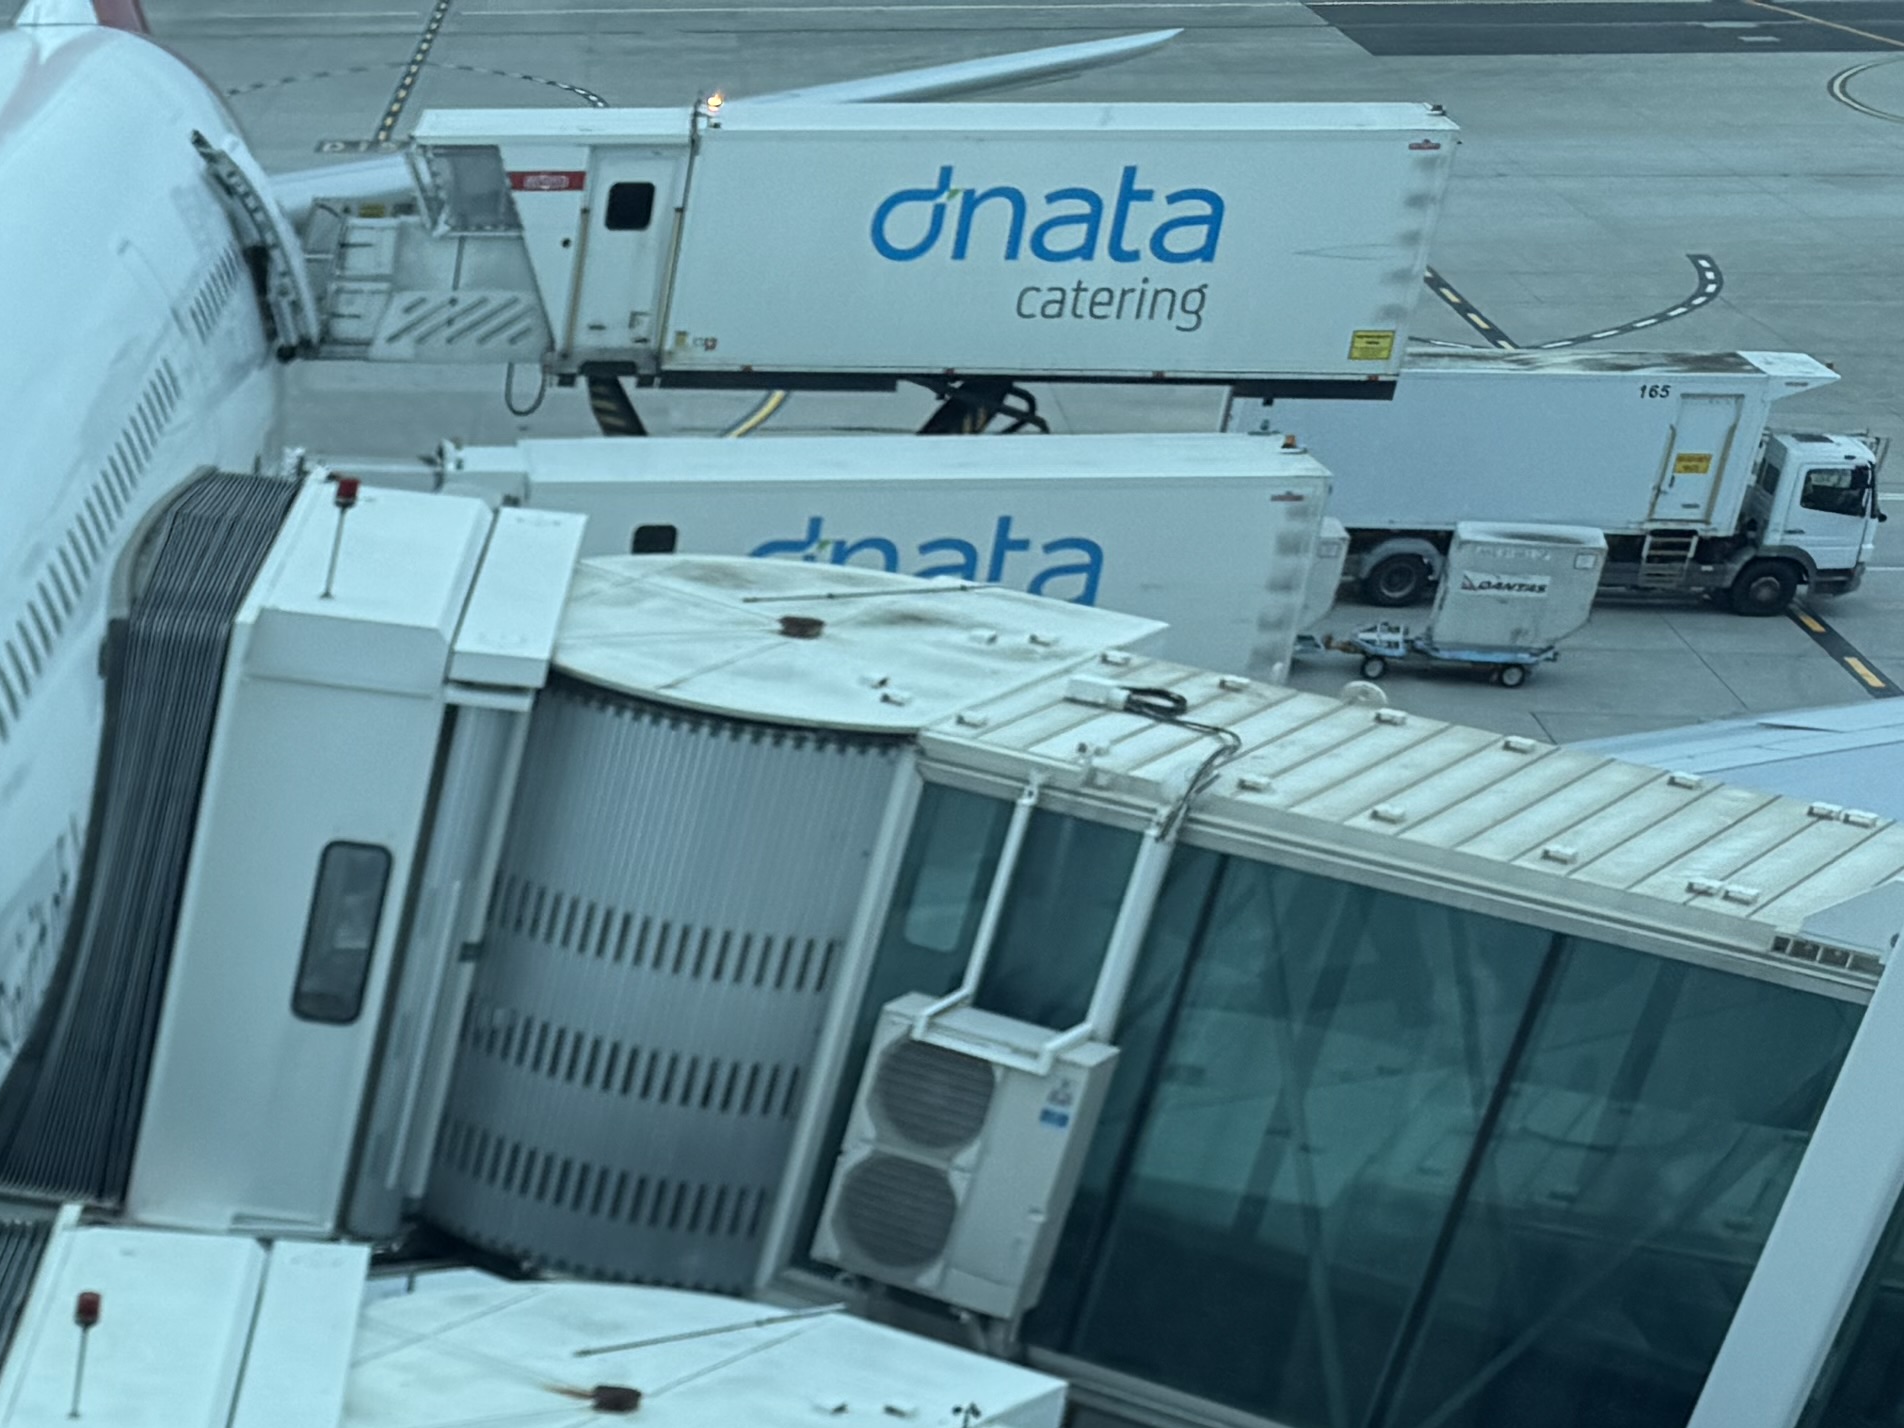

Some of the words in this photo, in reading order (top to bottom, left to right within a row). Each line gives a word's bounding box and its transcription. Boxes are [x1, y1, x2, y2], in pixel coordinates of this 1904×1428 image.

[869, 165, 1226, 265] dnata
[1015, 277, 1210, 333] catering
[1639, 383, 1672, 400] 165
[1476, 577, 1548, 594] QANTAS
